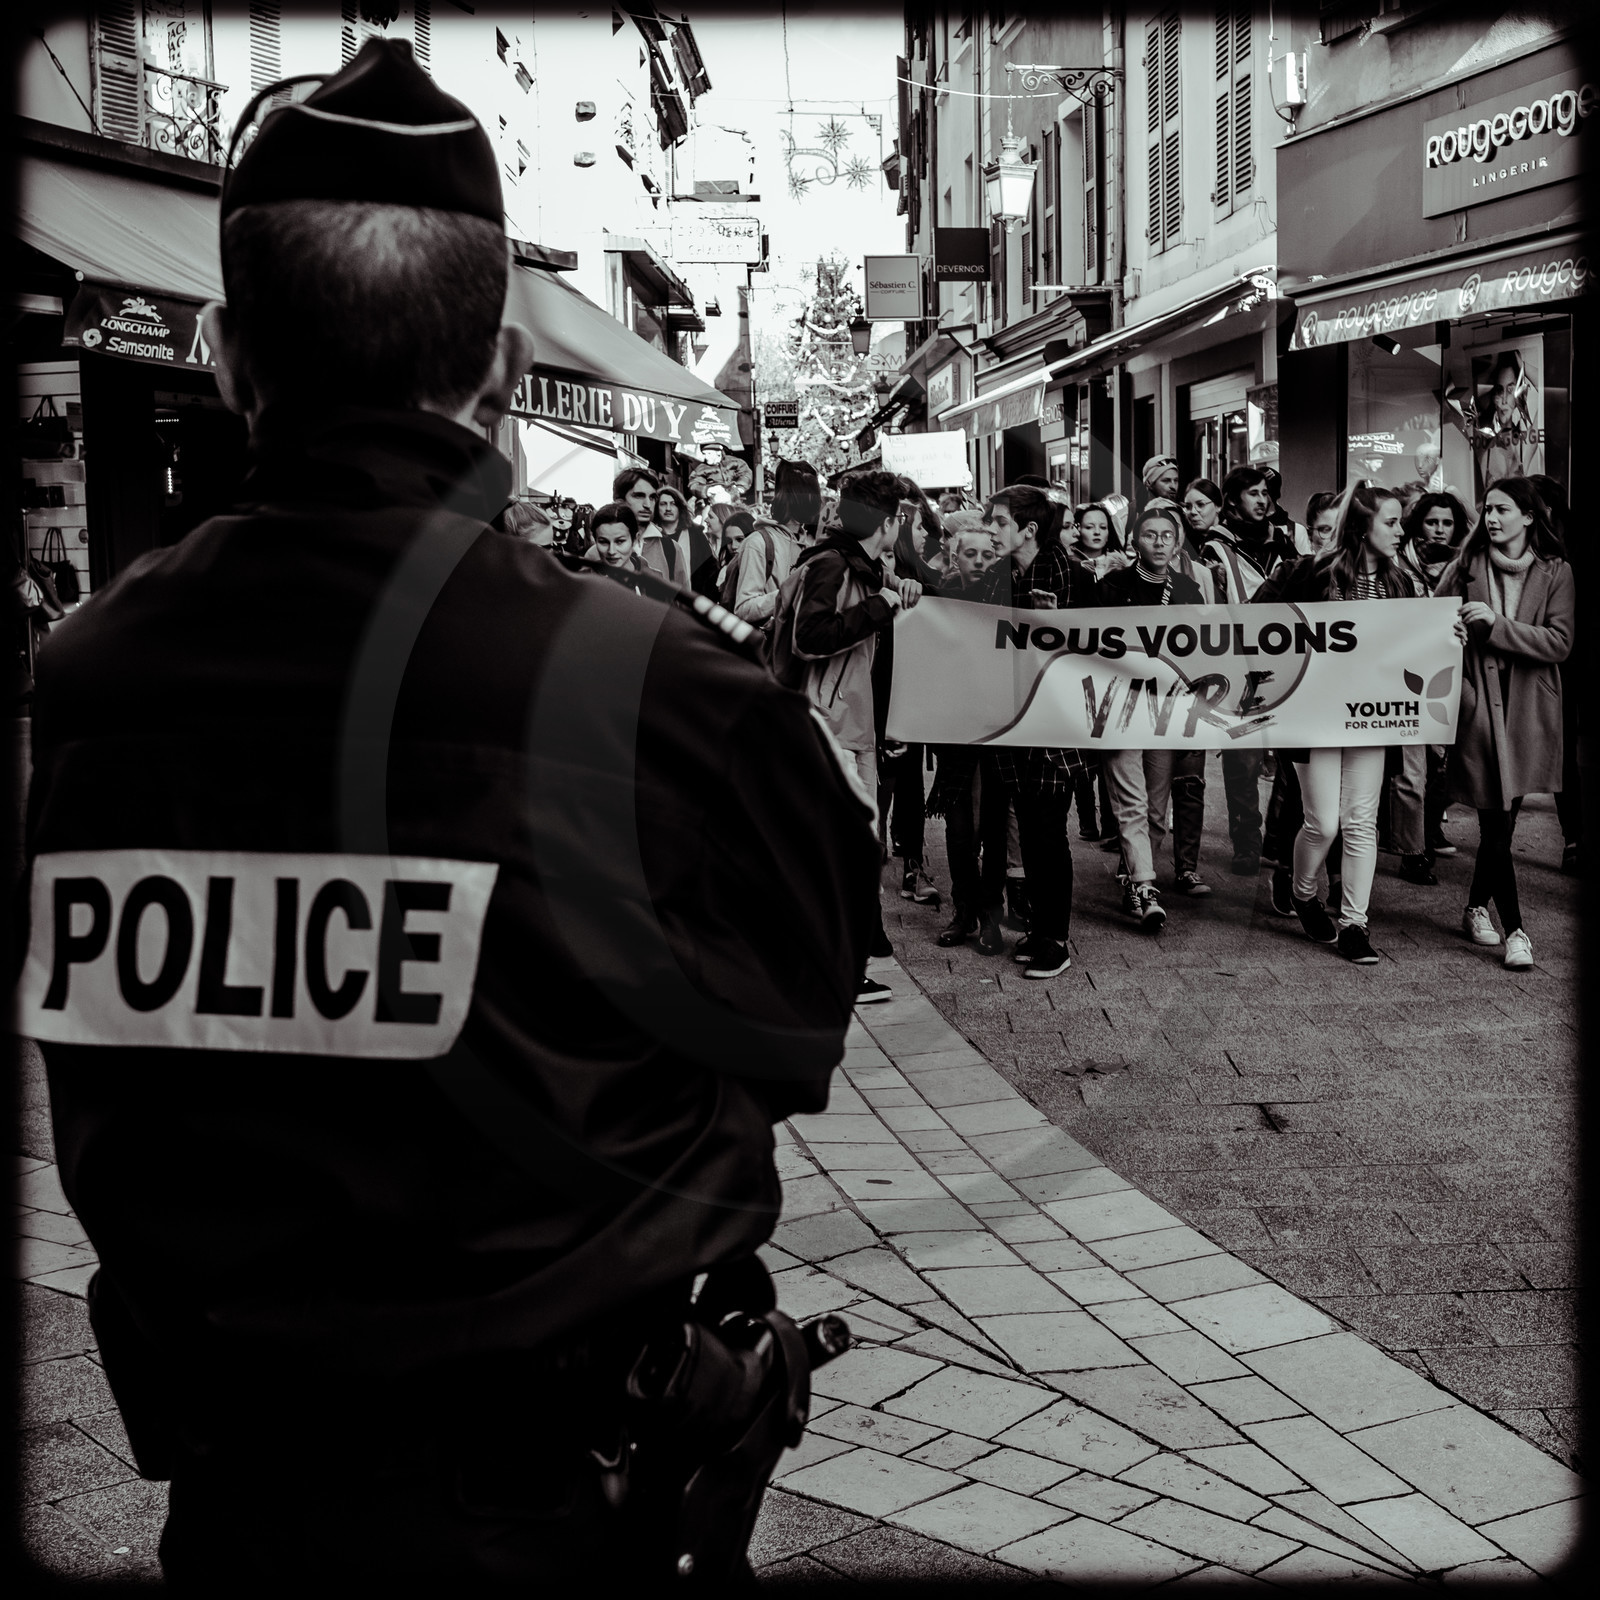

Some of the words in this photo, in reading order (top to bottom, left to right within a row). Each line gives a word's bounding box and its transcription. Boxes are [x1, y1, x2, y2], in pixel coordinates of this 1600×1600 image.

[1472, 156, 1549, 188] LINGERIE
[936, 264, 985, 274] DEVERNOIS
[869, 281, 907, 290] Sébastien
[100, 318, 171, 338] LONGCHAMP
[106, 336, 175, 361] Samsonite
[766, 402, 798, 415] COIFFURE
[995, 619, 1127, 660] NOUS
[1135, 619, 1359, 658] VOULONS
[1081, 669, 1278, 740] VIVRE
[1345, 700, 1420, 718] YOUTH
[1345, 721, 1369, 730] FOR
[1370, 719, 1420, 729] CLIMATE
[1399, 730, 1420, 738] GAP
[41, 874, 454, 1025] POLICE
